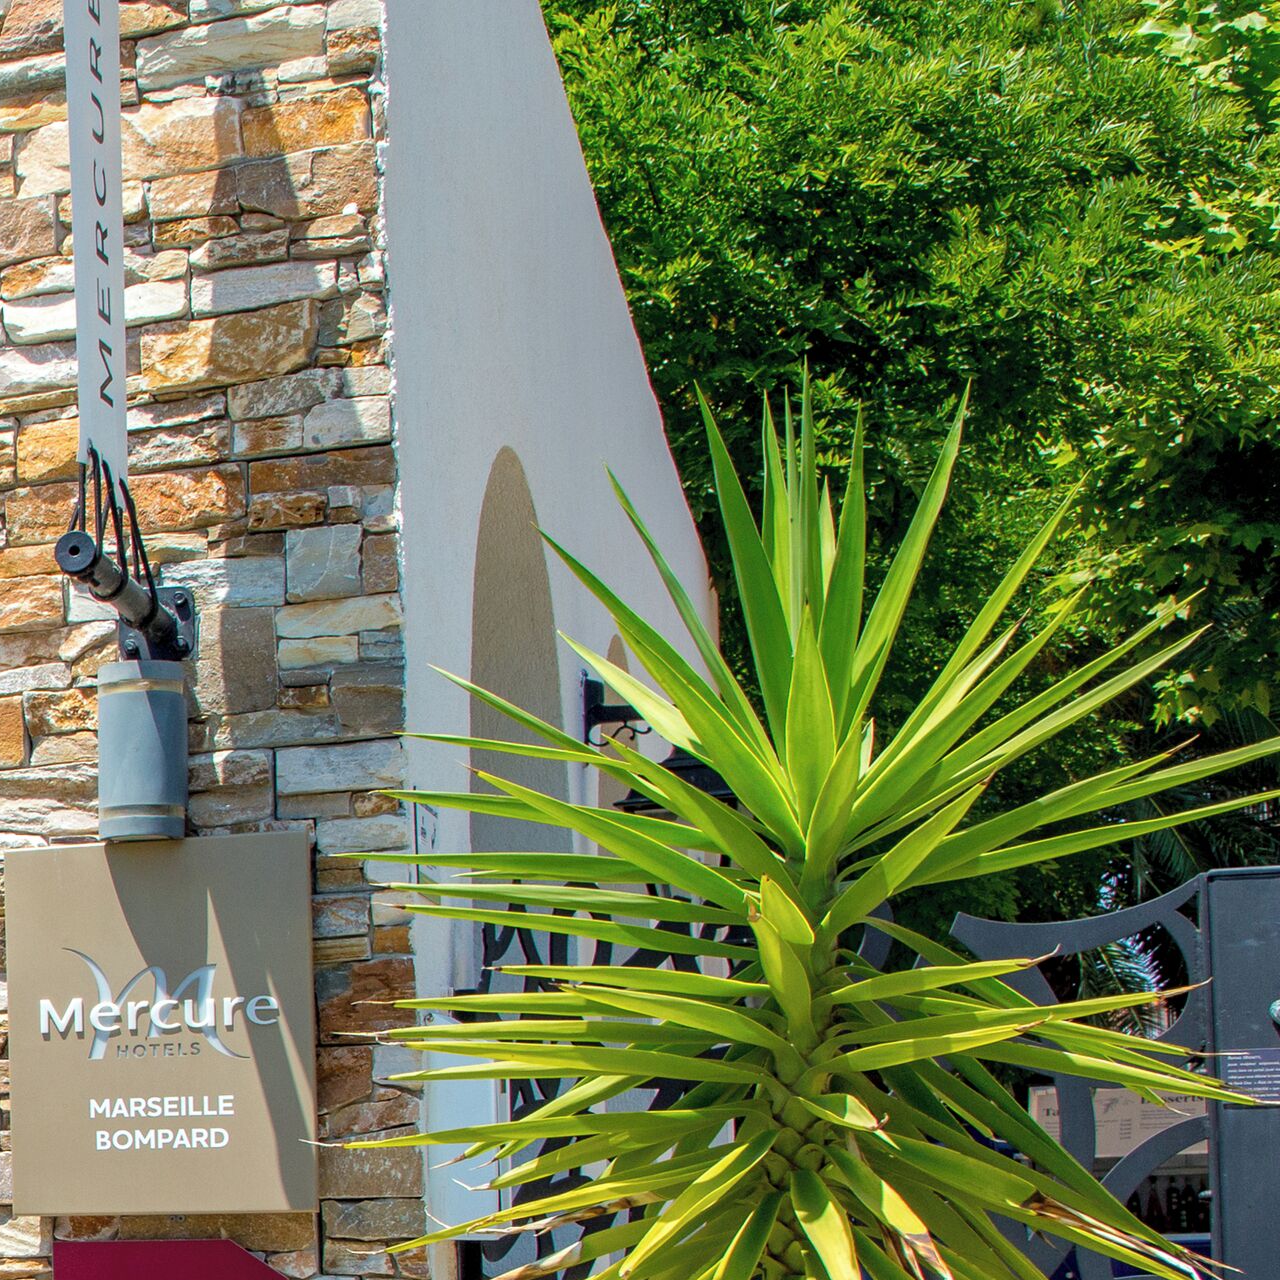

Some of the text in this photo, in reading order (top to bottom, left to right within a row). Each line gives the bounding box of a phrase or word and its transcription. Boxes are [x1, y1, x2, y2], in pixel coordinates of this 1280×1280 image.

[85, 0, 115, 408] MERCURE
[40, 994, 281, 1035] Mercure
[115, 1041, 201, 1059] HOTELS
[88, 1094, 235, 1120] MARSEILLE
[95, 1127, 230, 1152] BOMPARD
